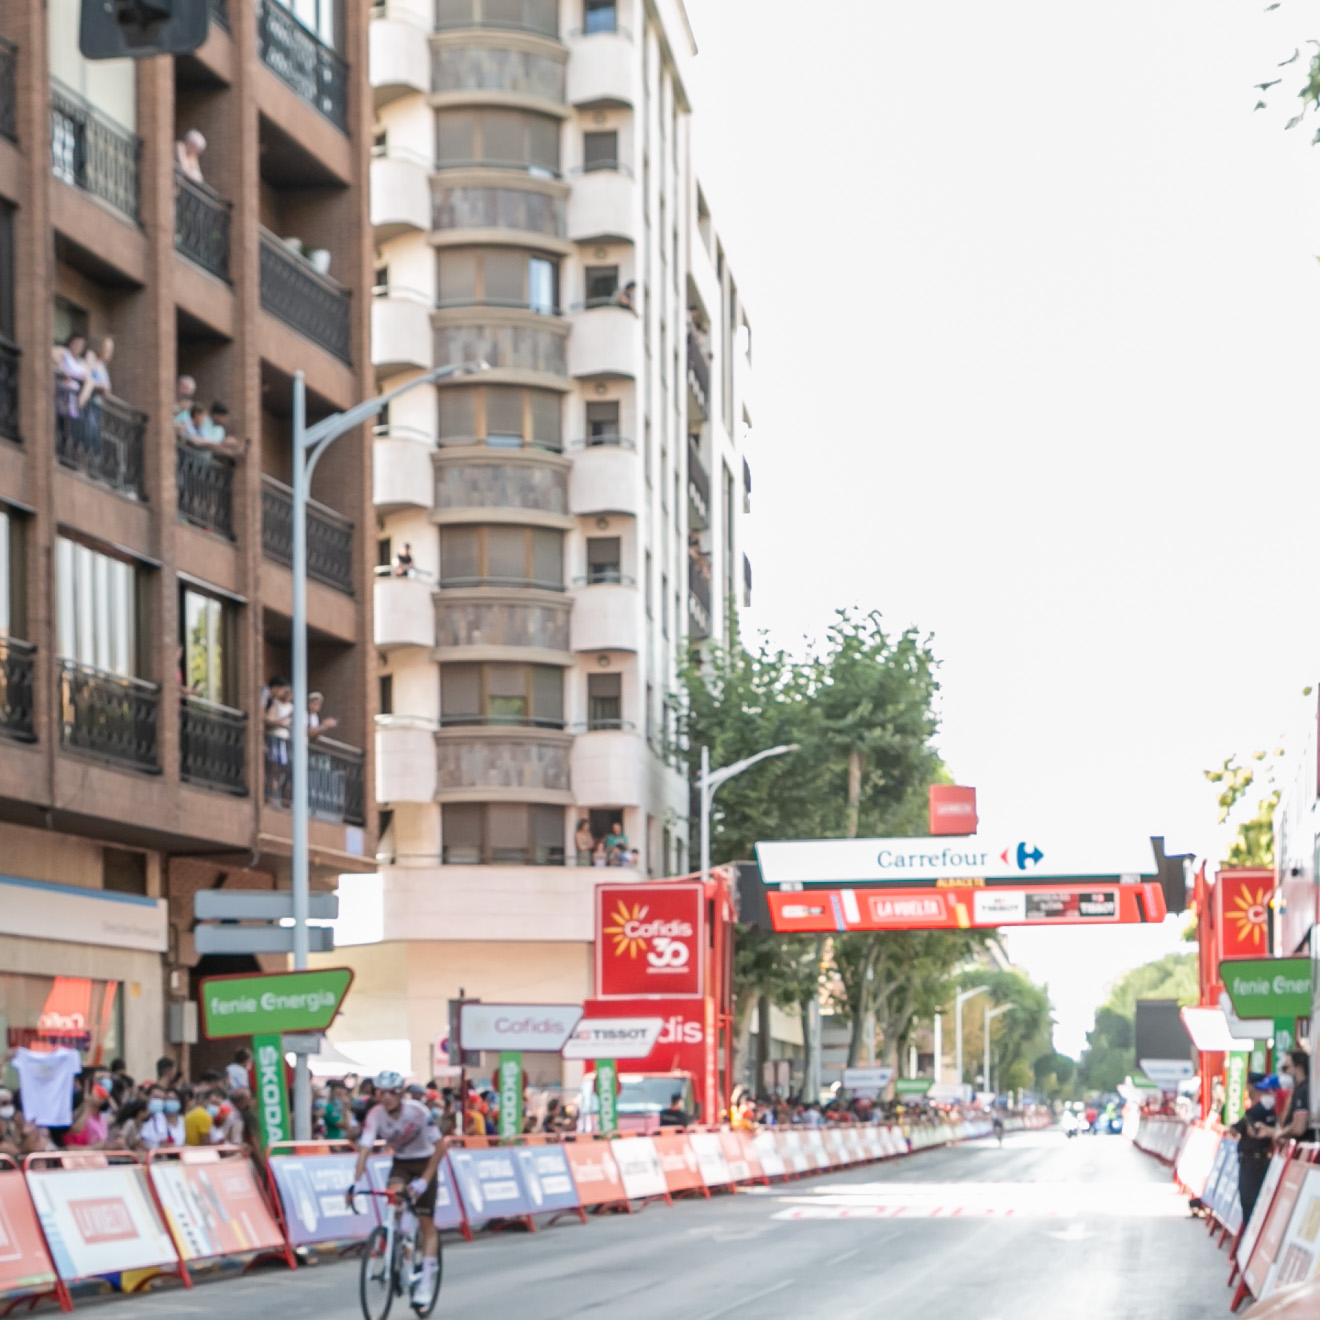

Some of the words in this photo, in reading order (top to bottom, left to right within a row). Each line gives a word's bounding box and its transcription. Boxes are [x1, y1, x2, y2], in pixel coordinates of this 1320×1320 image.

[876, 848, 988, 869] Carrefour
[623, 918, 693, 938] Cofidis
[646, 936, 690, 967] 30
[493, 1017, 566, 1035] Cofidis
[591, 1028, 649, 1040] TISSOT
[656, 1015, 704, 1045] dis
